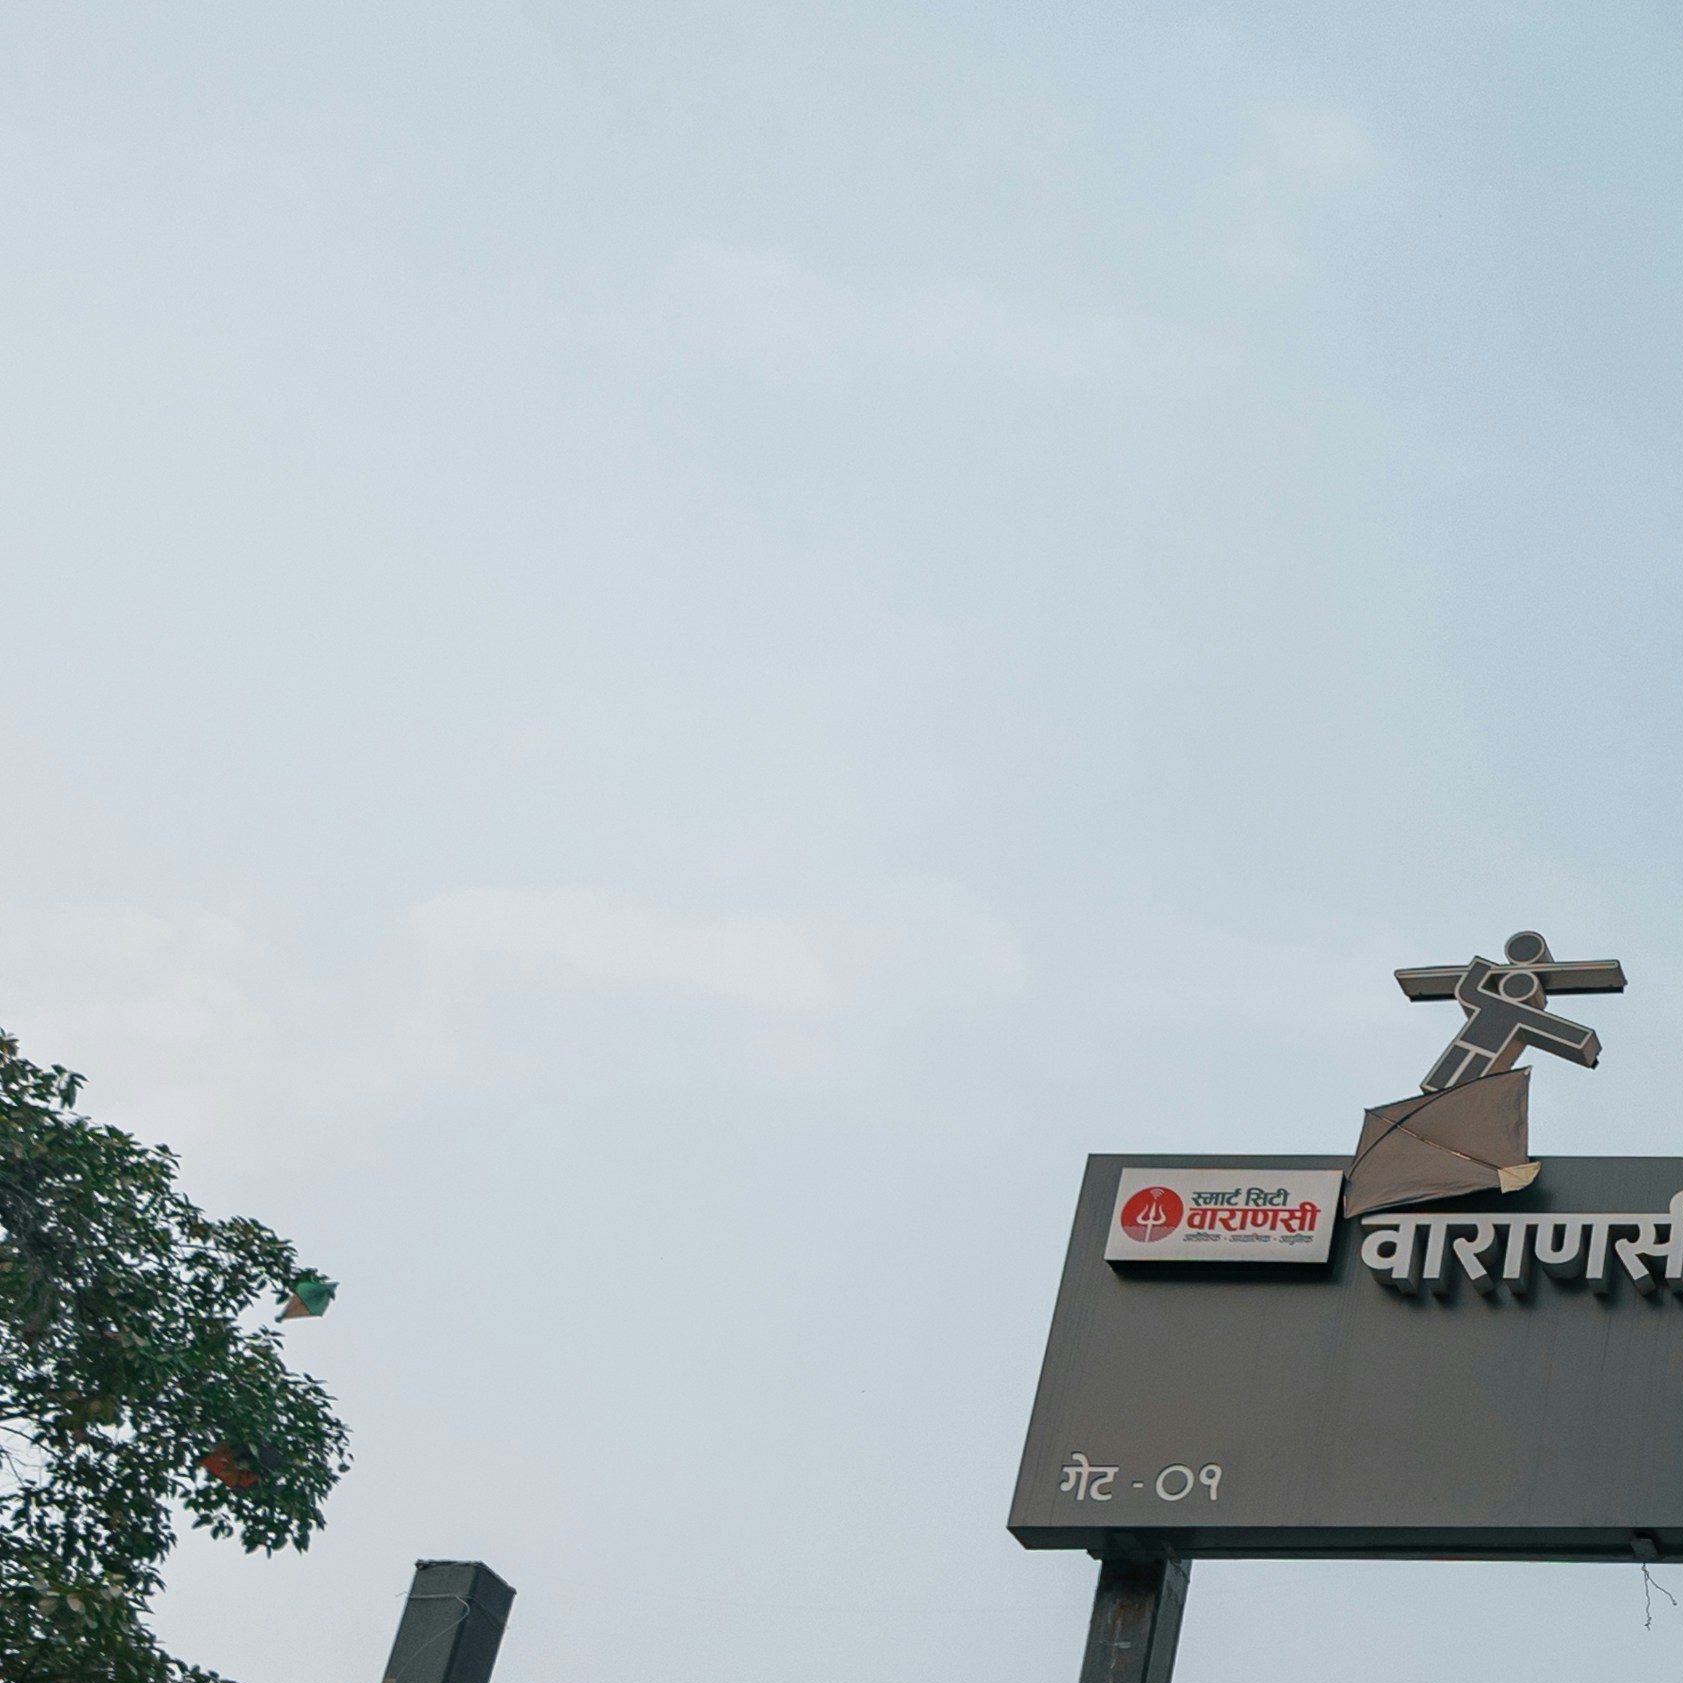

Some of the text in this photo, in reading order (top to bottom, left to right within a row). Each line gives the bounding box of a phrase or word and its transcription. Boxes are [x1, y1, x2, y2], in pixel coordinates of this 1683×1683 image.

[1191, 1187, 1291, 1208] स्मार्ट सिटी
[1186, 1201, 1322, 1233] वाराणसी
[1058, 1451, 1120, 1502] गेट
[1154, 1461, 1224, 1502] ०१
